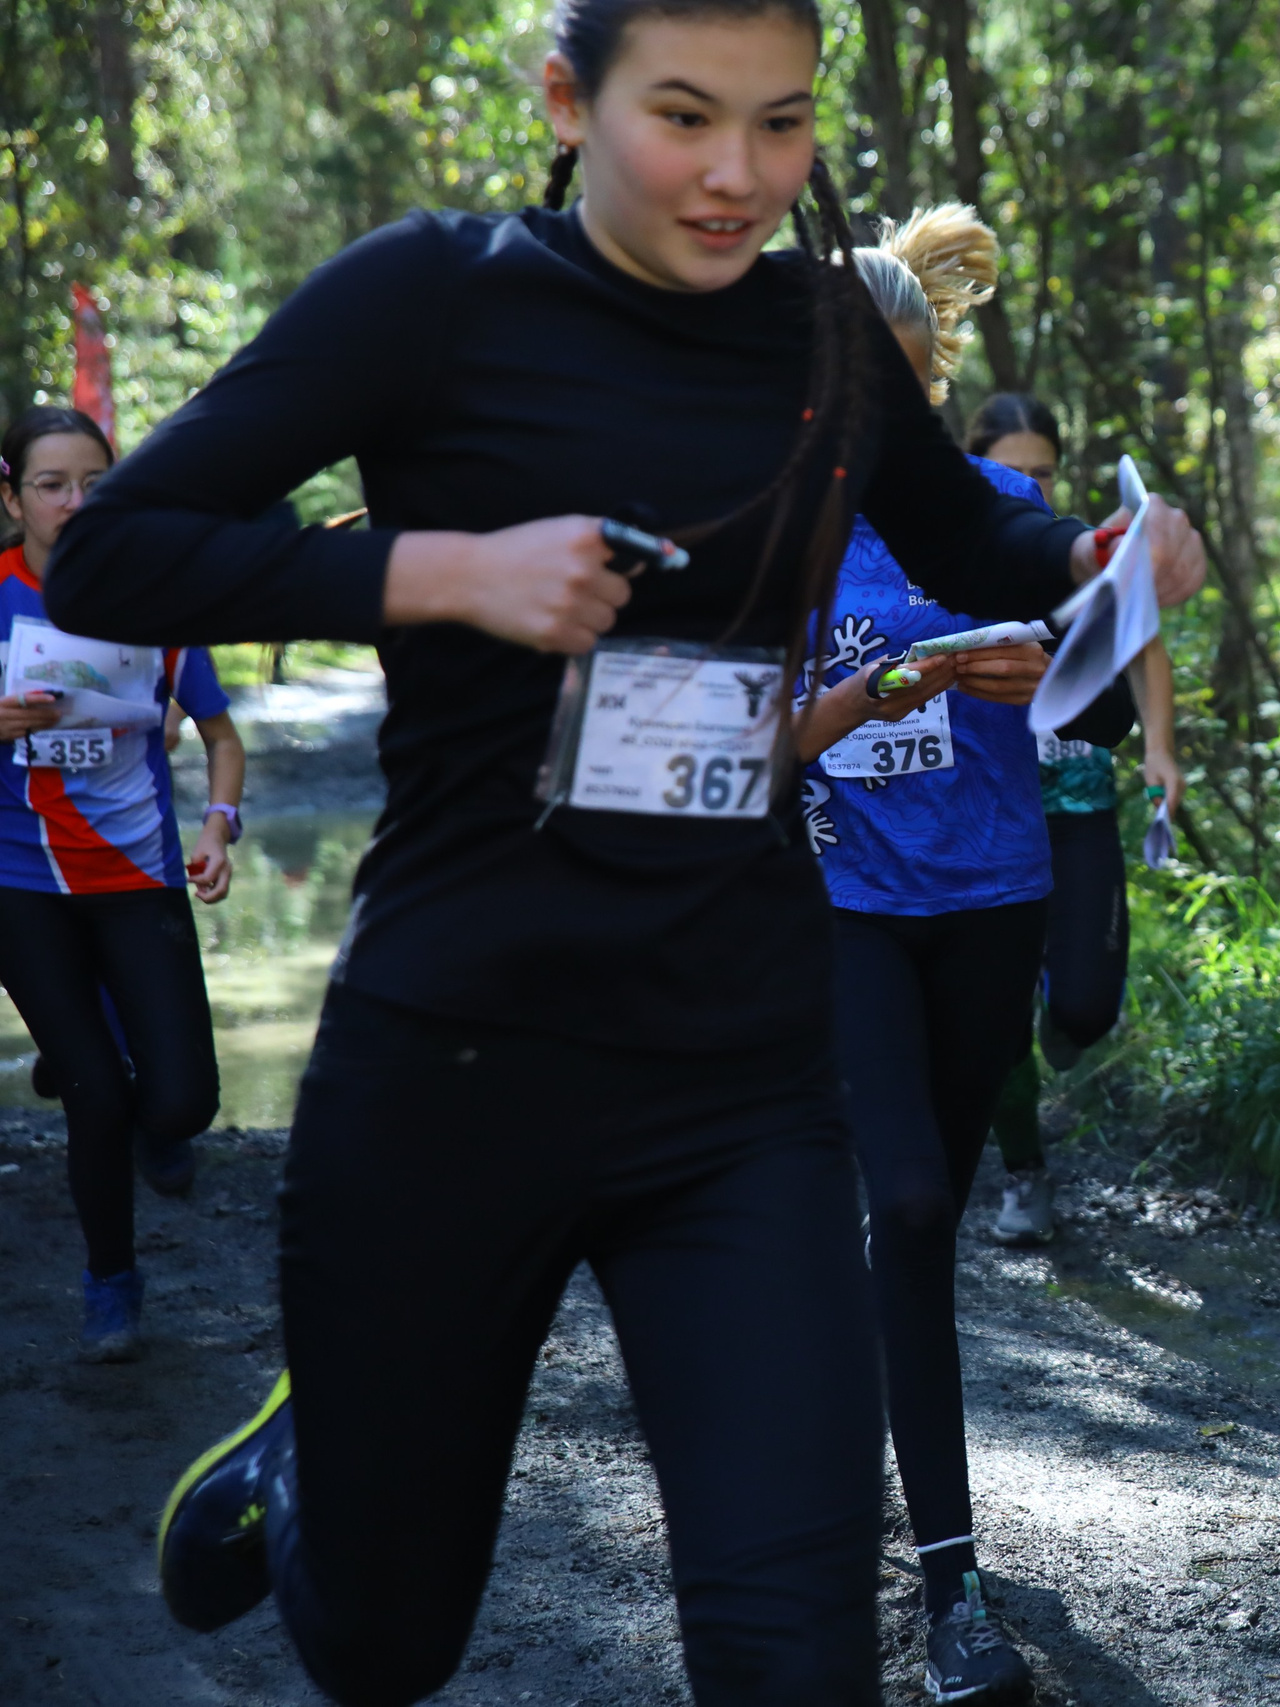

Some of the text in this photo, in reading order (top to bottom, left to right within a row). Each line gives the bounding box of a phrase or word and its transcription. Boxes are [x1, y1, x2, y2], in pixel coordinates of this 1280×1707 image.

[843, 728, 929, 742] 4_ОДЮСШ-Кучин Чел
[883, 718, 920, 729] Вероника
[49, 739, 105, 765] 355
[871, 735, 943, 774] 376
[662, 754, 767, 811] 367
